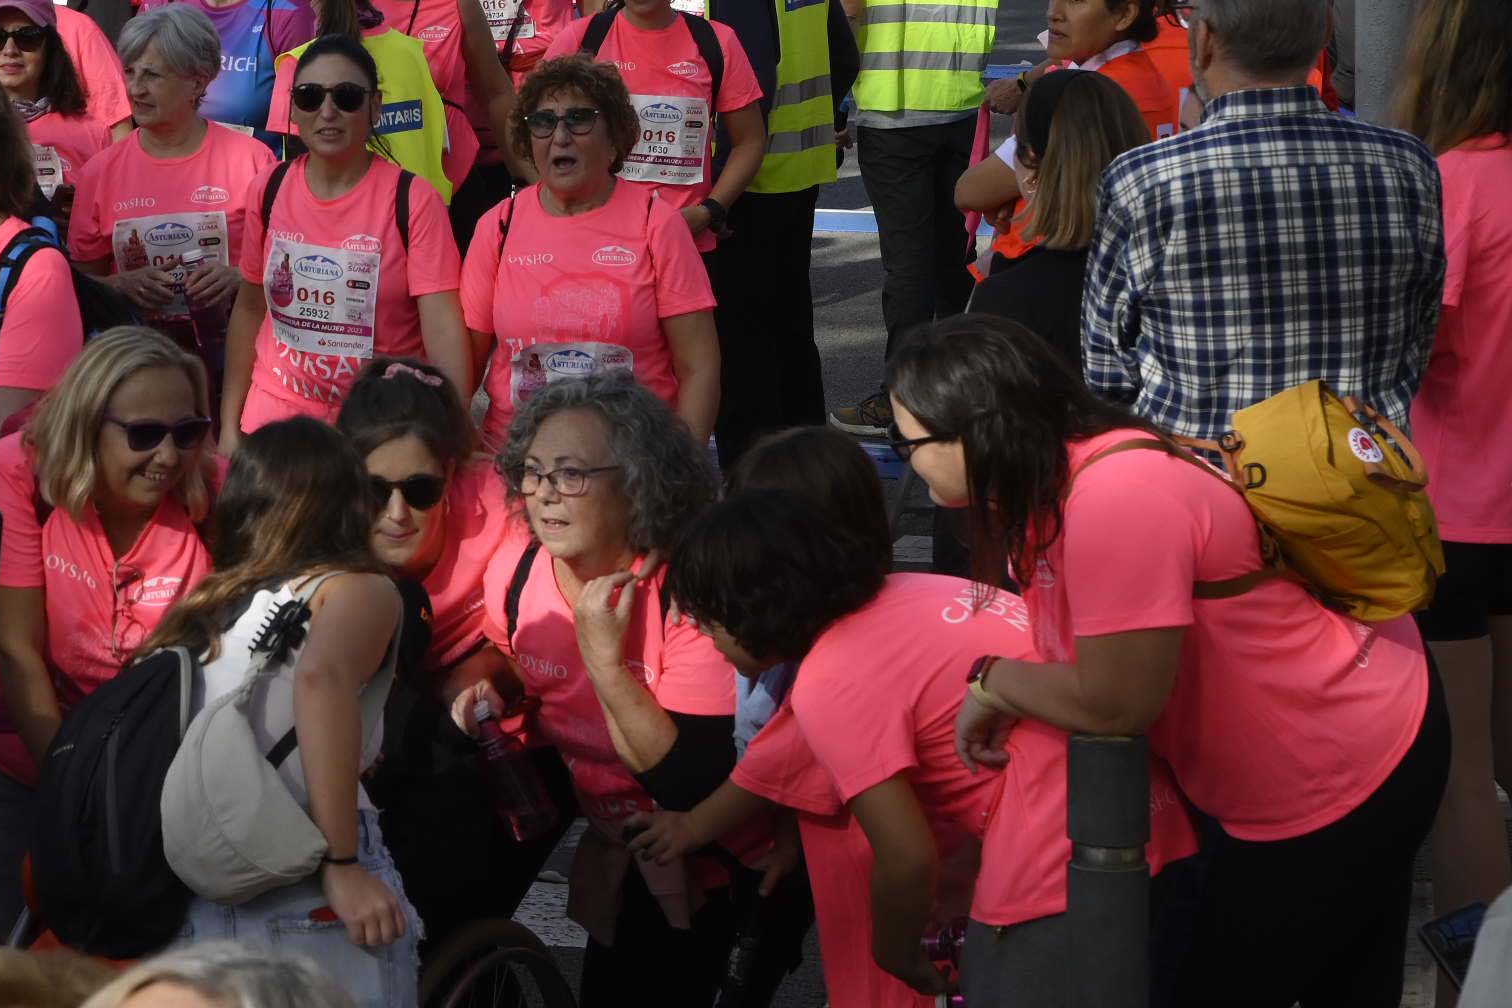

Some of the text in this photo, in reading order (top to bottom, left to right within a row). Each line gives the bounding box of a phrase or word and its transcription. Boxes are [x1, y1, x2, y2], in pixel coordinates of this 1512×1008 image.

[482, 0, 506, 10] 016
[614, 60, 636, 71] SHO
[644, 109, 680, 120] ASTURIANA
[643, 129, 676, 143] 016
[648, 145, 668, 154] 1630
[621, 165, 645, 174] YSHO
[113, 197, 156, 212] OYSHO
[297, 262, 340, 277] ASTURIANA
[297, 287, 335, 306] 016
[299, 306, 330, 320] 25932
[301, 320, 310, 328] DE
[311, 321, 320, 329] LA
[321, 323, 345, 333] MUJER
[327, 339, 365, 350] Santander
[550, 357, 594, 370] ASTURIANA
[519, 654, 568, 679] OYSHO
